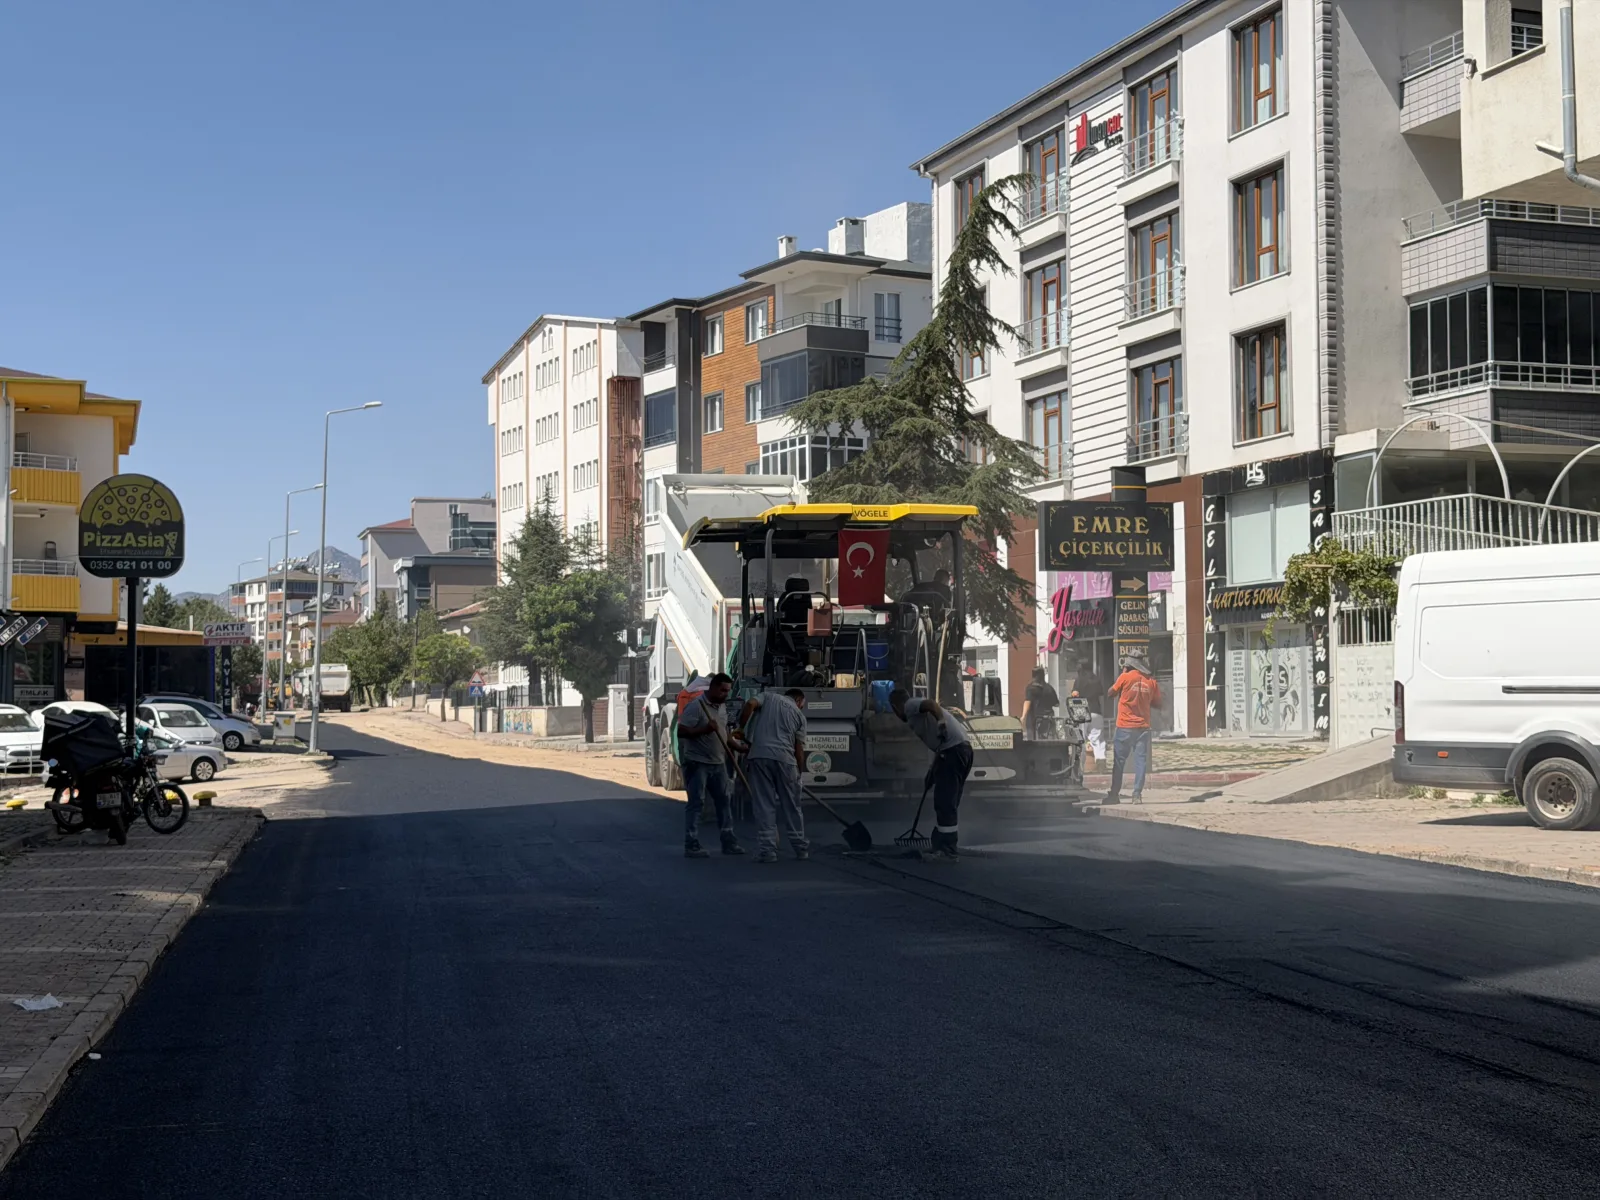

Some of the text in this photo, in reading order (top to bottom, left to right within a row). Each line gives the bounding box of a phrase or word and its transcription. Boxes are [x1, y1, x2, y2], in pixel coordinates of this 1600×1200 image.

[854, 508, 889, 518] VÖGELE
[1072, 515, 1150, 535] EMRE
[83, 530, 165, 548] PizzAsia
[1058, 537, 1164, 558] ÇİÇEKÇİLİK
[90, 560, 172, 570] 0352 621 01 00
[1047, 584, 1105, 653] Yasemin
